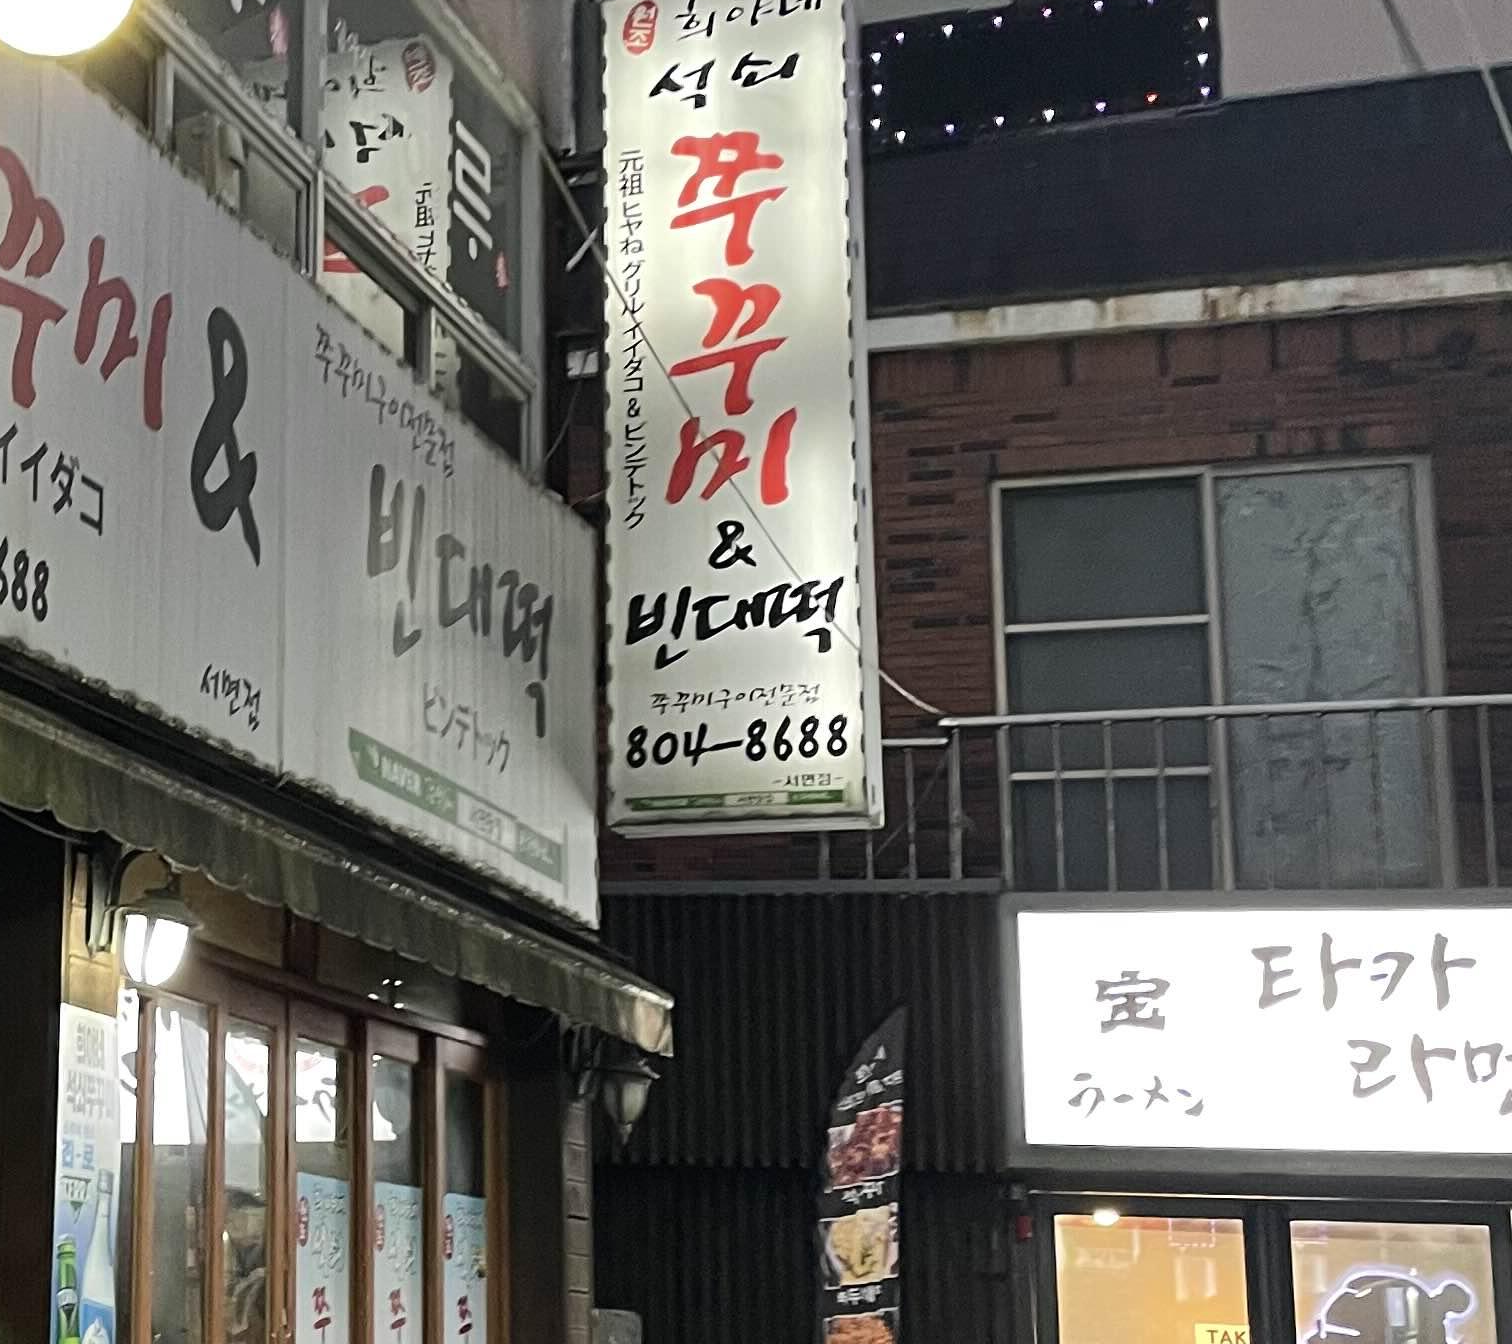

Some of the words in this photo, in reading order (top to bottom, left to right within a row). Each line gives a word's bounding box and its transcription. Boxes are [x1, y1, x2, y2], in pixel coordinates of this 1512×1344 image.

[648, 50, 800, 110] 석쇠
[664, 130, 797, 506] 쭈꾸미
[190, 306, 261, 567] &
[707, 519, 757, 570] &
[365, 463, 555, 739] 빈대떡
[624, 575, 845, 671] 빈대떡
[199, 662, 263, 732] 서면점
[625, 713, 849, 769] 804-8688
[1250, 931, 1478, 1012] 타카
[1067, 1071, 1205, 1119] ラーメン
